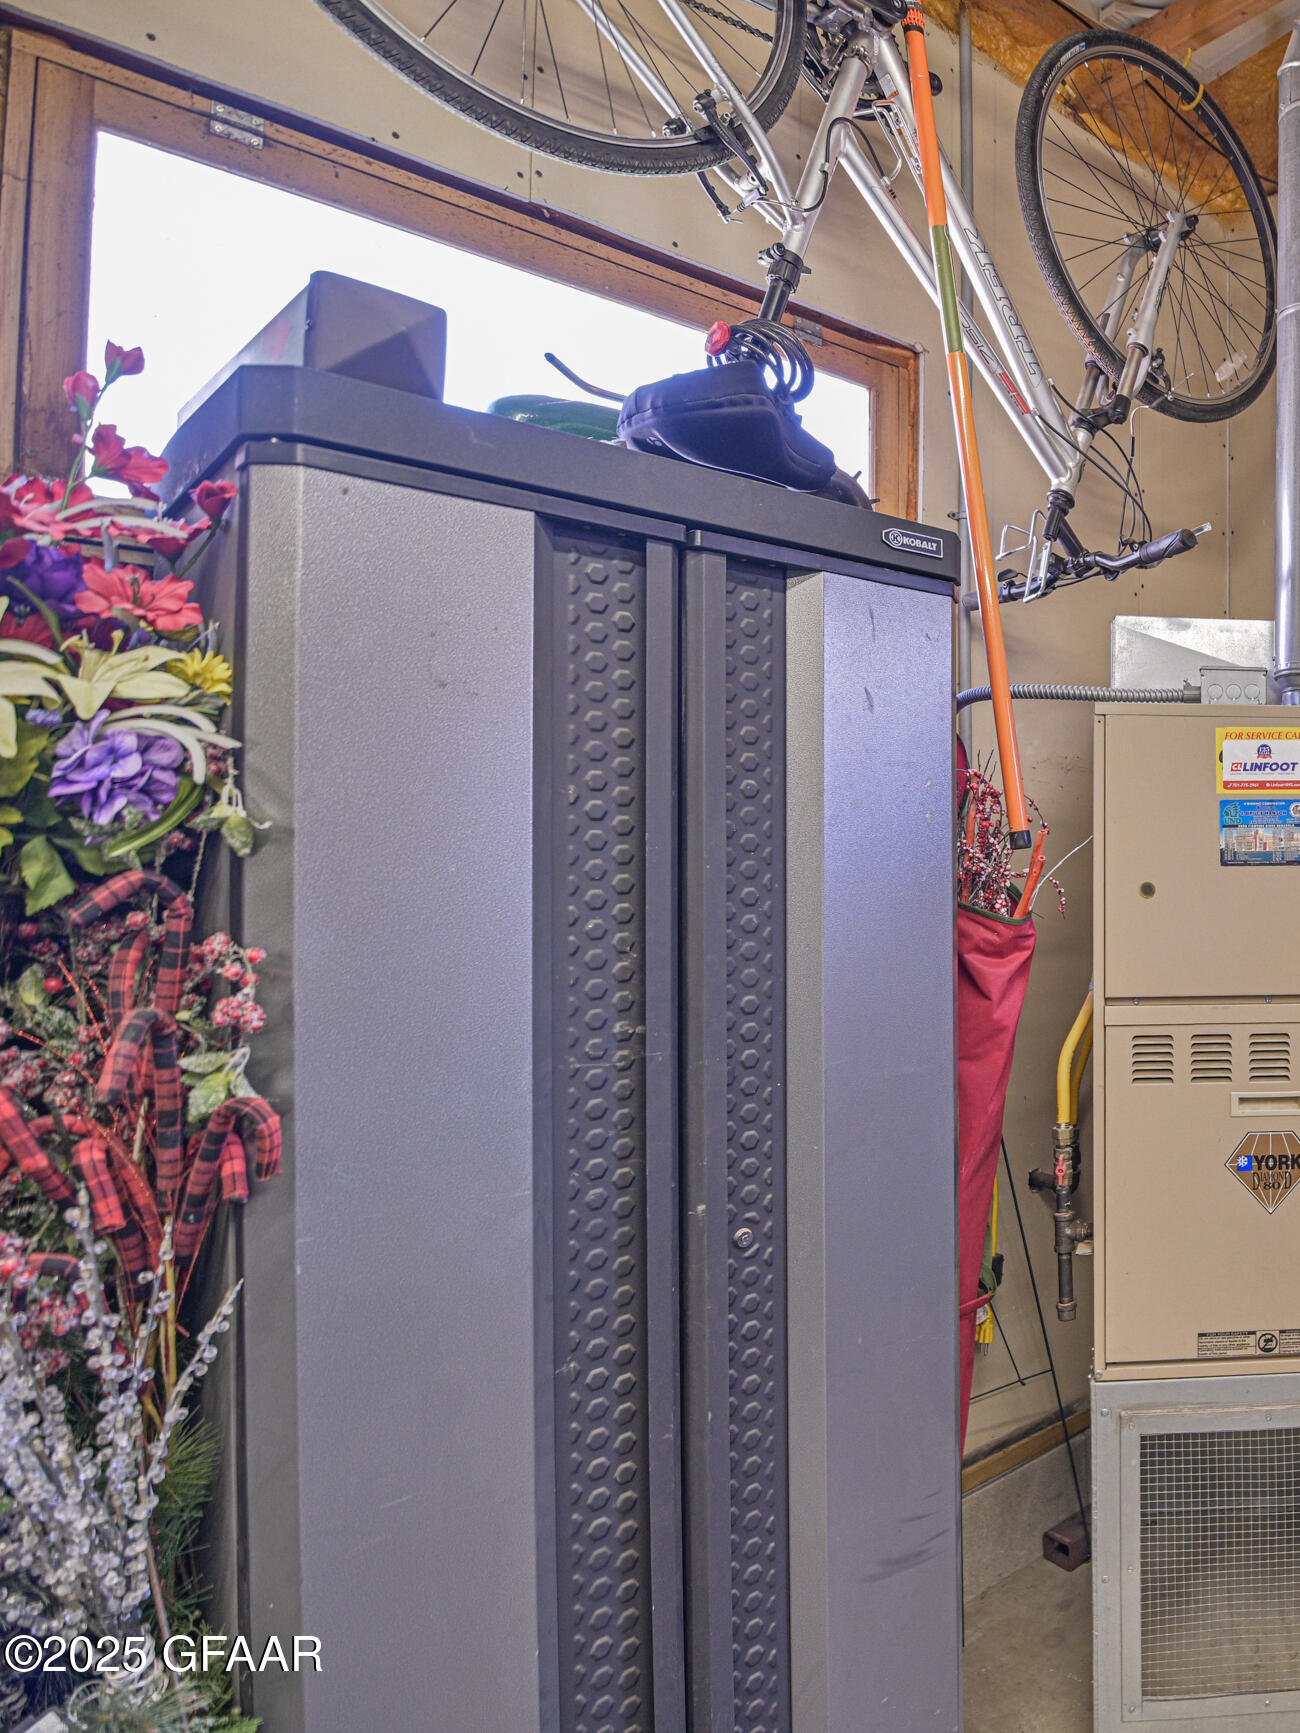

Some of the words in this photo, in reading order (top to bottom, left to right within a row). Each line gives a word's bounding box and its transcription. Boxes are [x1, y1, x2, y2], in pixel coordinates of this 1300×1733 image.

[964, 228, 1041, 376] TREK
[903, 536, 938, 551] KOBALT
[1225, 731, 1244, 740] FOR
[1246, 731, 1283, 740] SERVICE
[1243, 762, 1299, 772] LINFOOT
[1253, 1171, 1292, 1190] DIAMOND
[1263, 1181, 1281, 1190] 80
